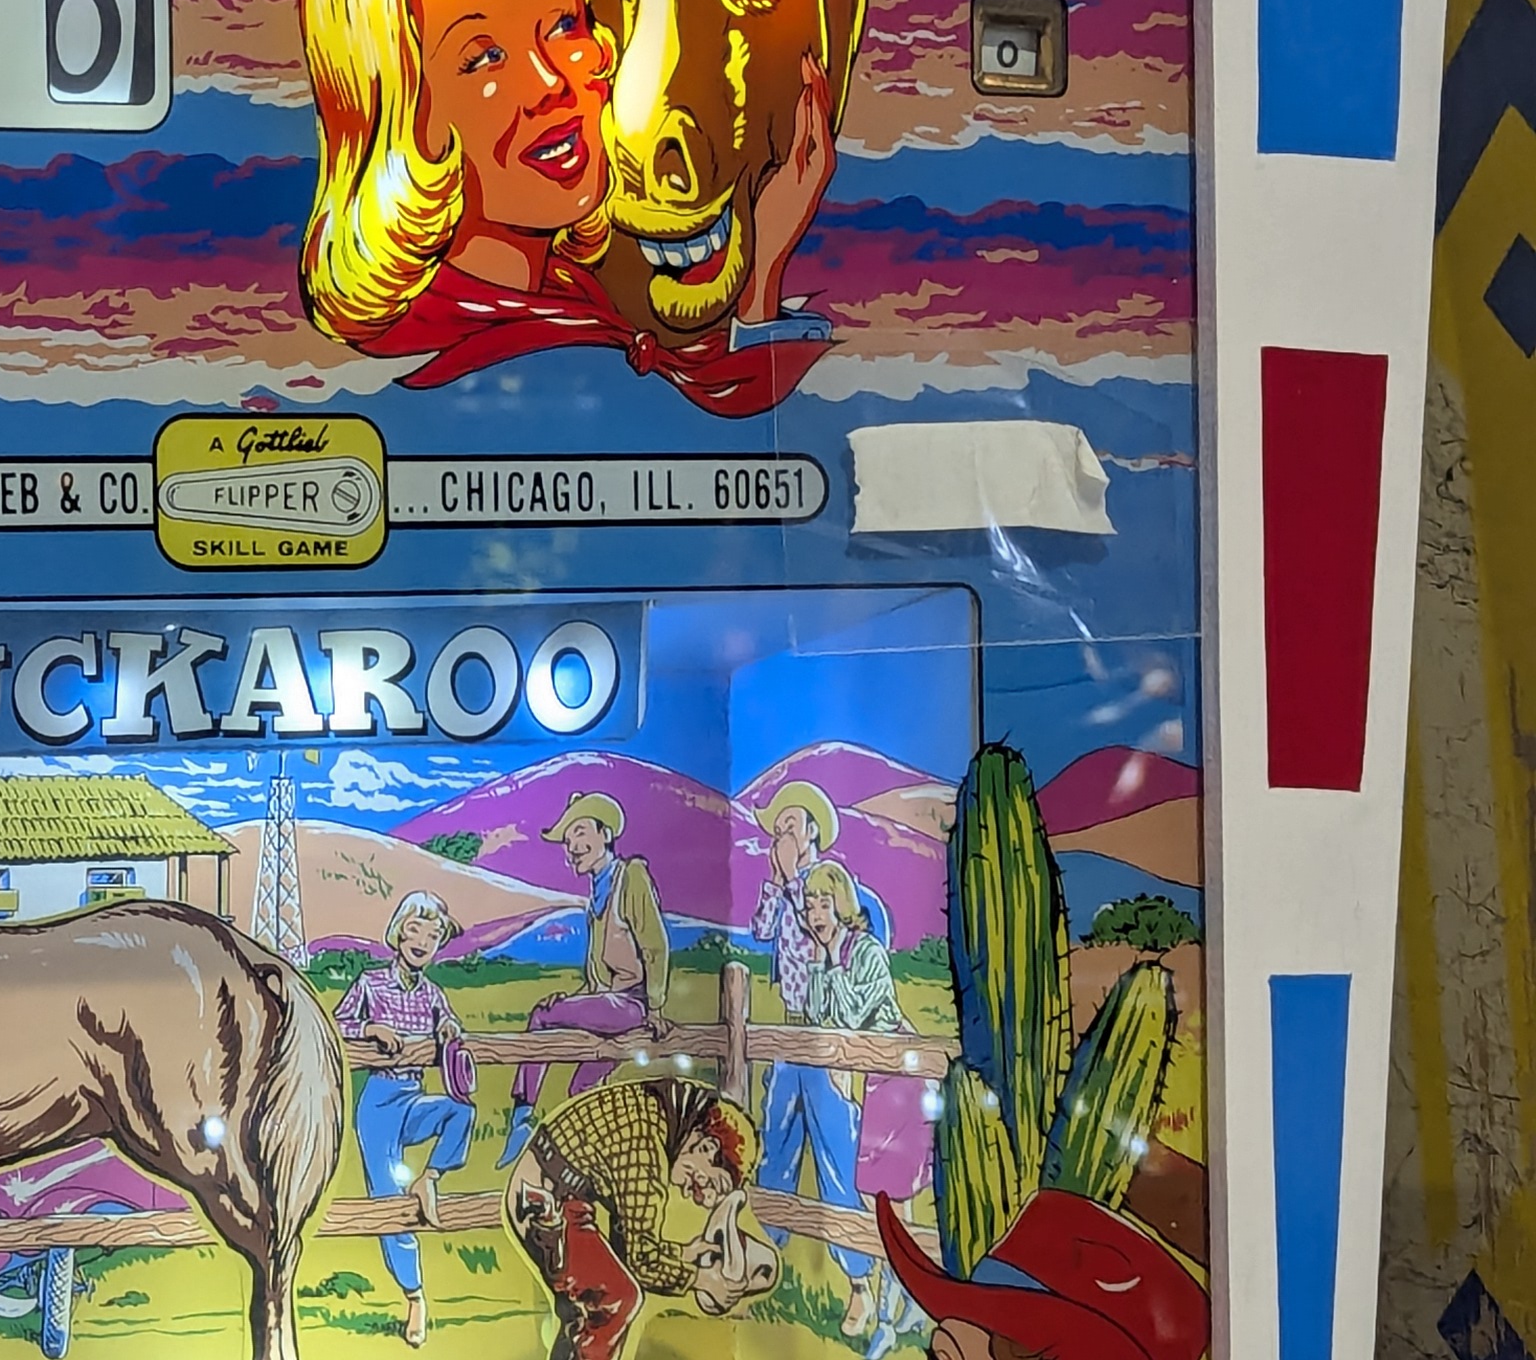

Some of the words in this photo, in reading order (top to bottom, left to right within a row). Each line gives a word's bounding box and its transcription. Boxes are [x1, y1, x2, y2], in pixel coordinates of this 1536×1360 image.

[996, 40, 1019, 68] 0
[209, 437, 224, 452] A
[237, 423, 331, 464] Gottlieb
[60, 471, 82, 514] &
[99, 471, 150, 516] CO.
[214, 480, 321, 513] FLIPPER
[632, 468, 694, 511] ILL.
[714, 467, 805, 510] 60651
[192, 540, 267, 557] SKILL
[278, 539, 349, 557] GAME
